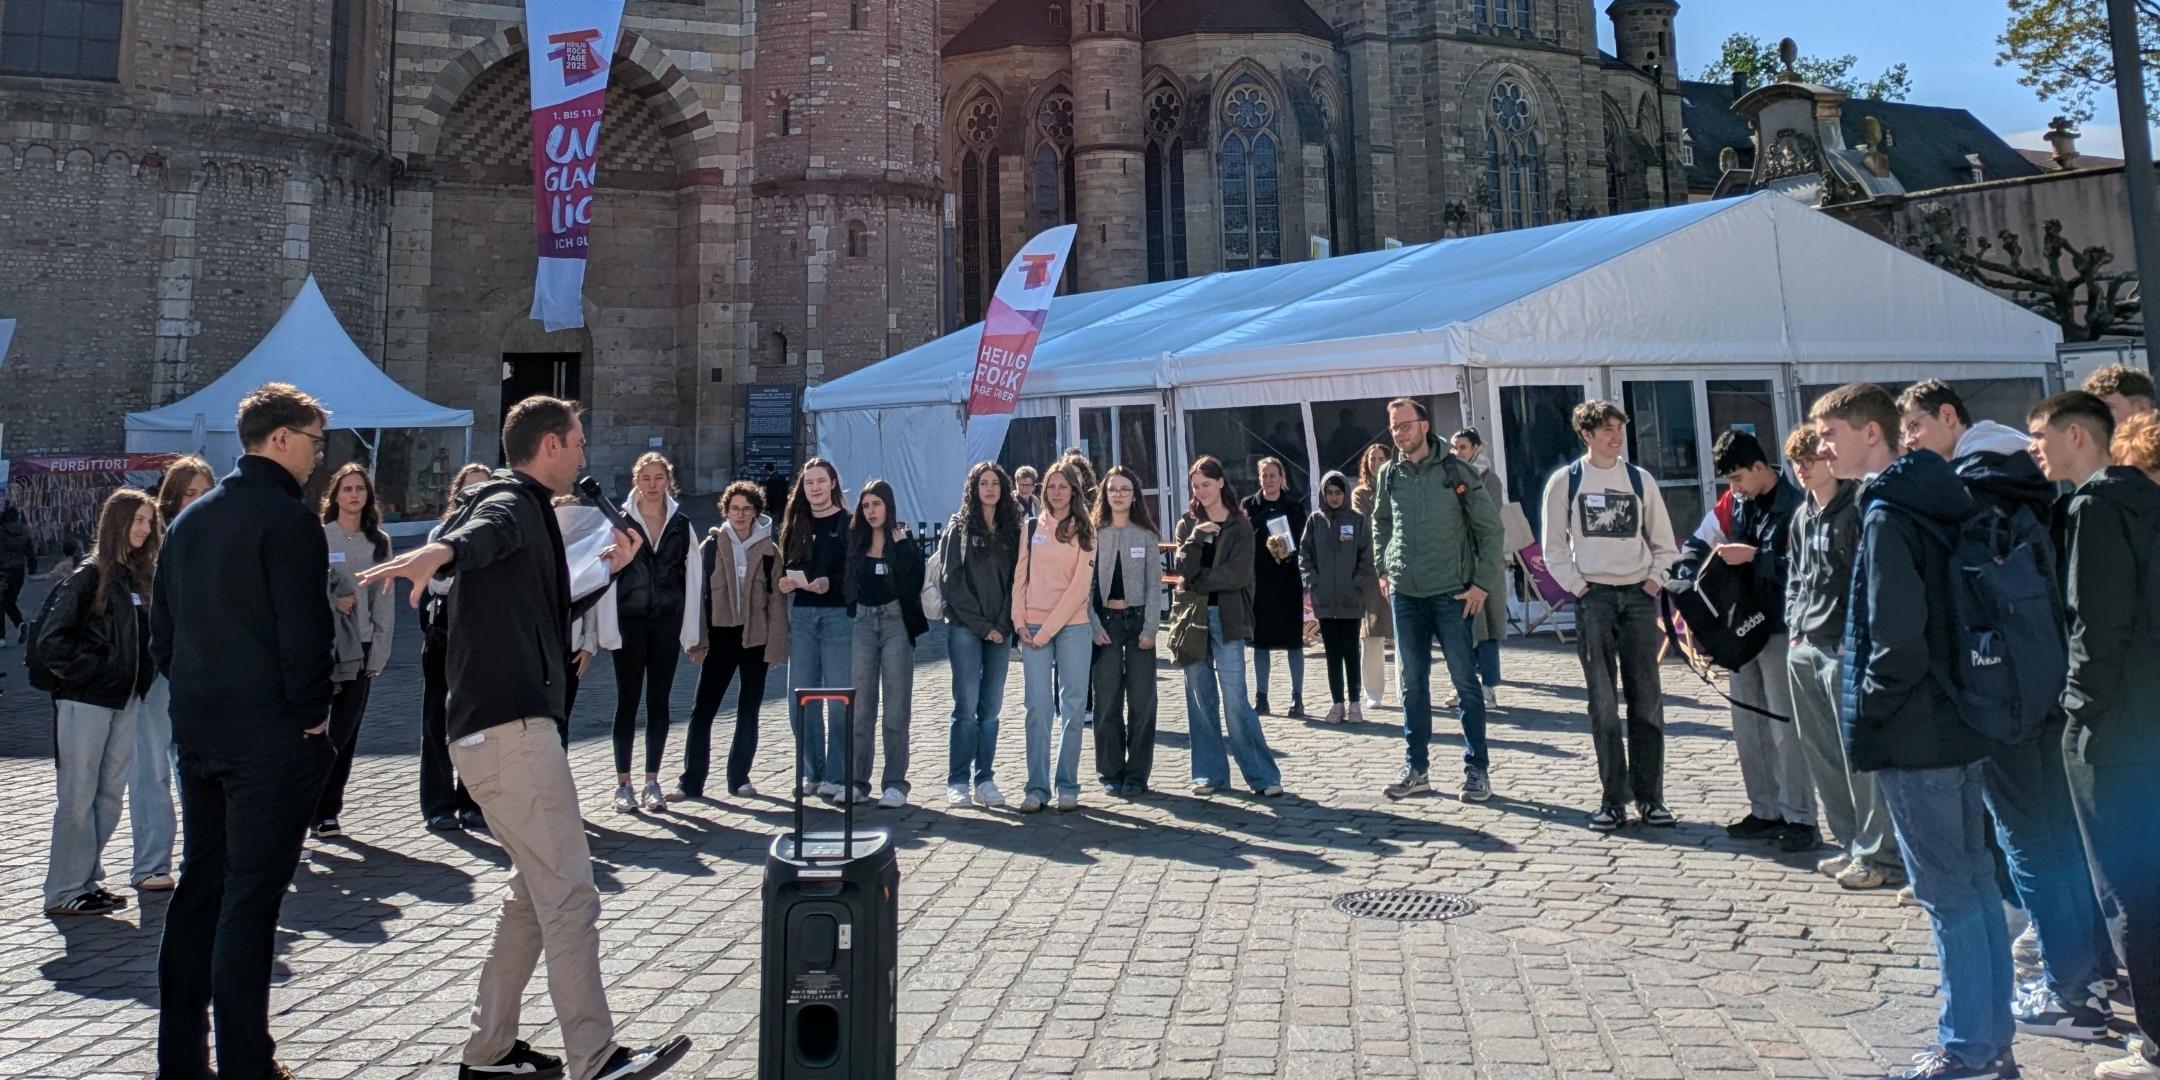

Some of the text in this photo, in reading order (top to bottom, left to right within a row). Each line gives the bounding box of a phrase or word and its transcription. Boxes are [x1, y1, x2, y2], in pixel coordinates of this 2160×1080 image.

[566, 54, 587, 62] TAGE
[566, 61, 587, 70] 2025
[553, 111, 561, 120] 1.
[563, 111, 579, 119] BIS
[582, 109, 595, 118] 11.
[555, 237, 574, 250] ICH
[50, 458, 129, 472] FÜRBITTORT
[1736, 611, 1766, 637] adidas
